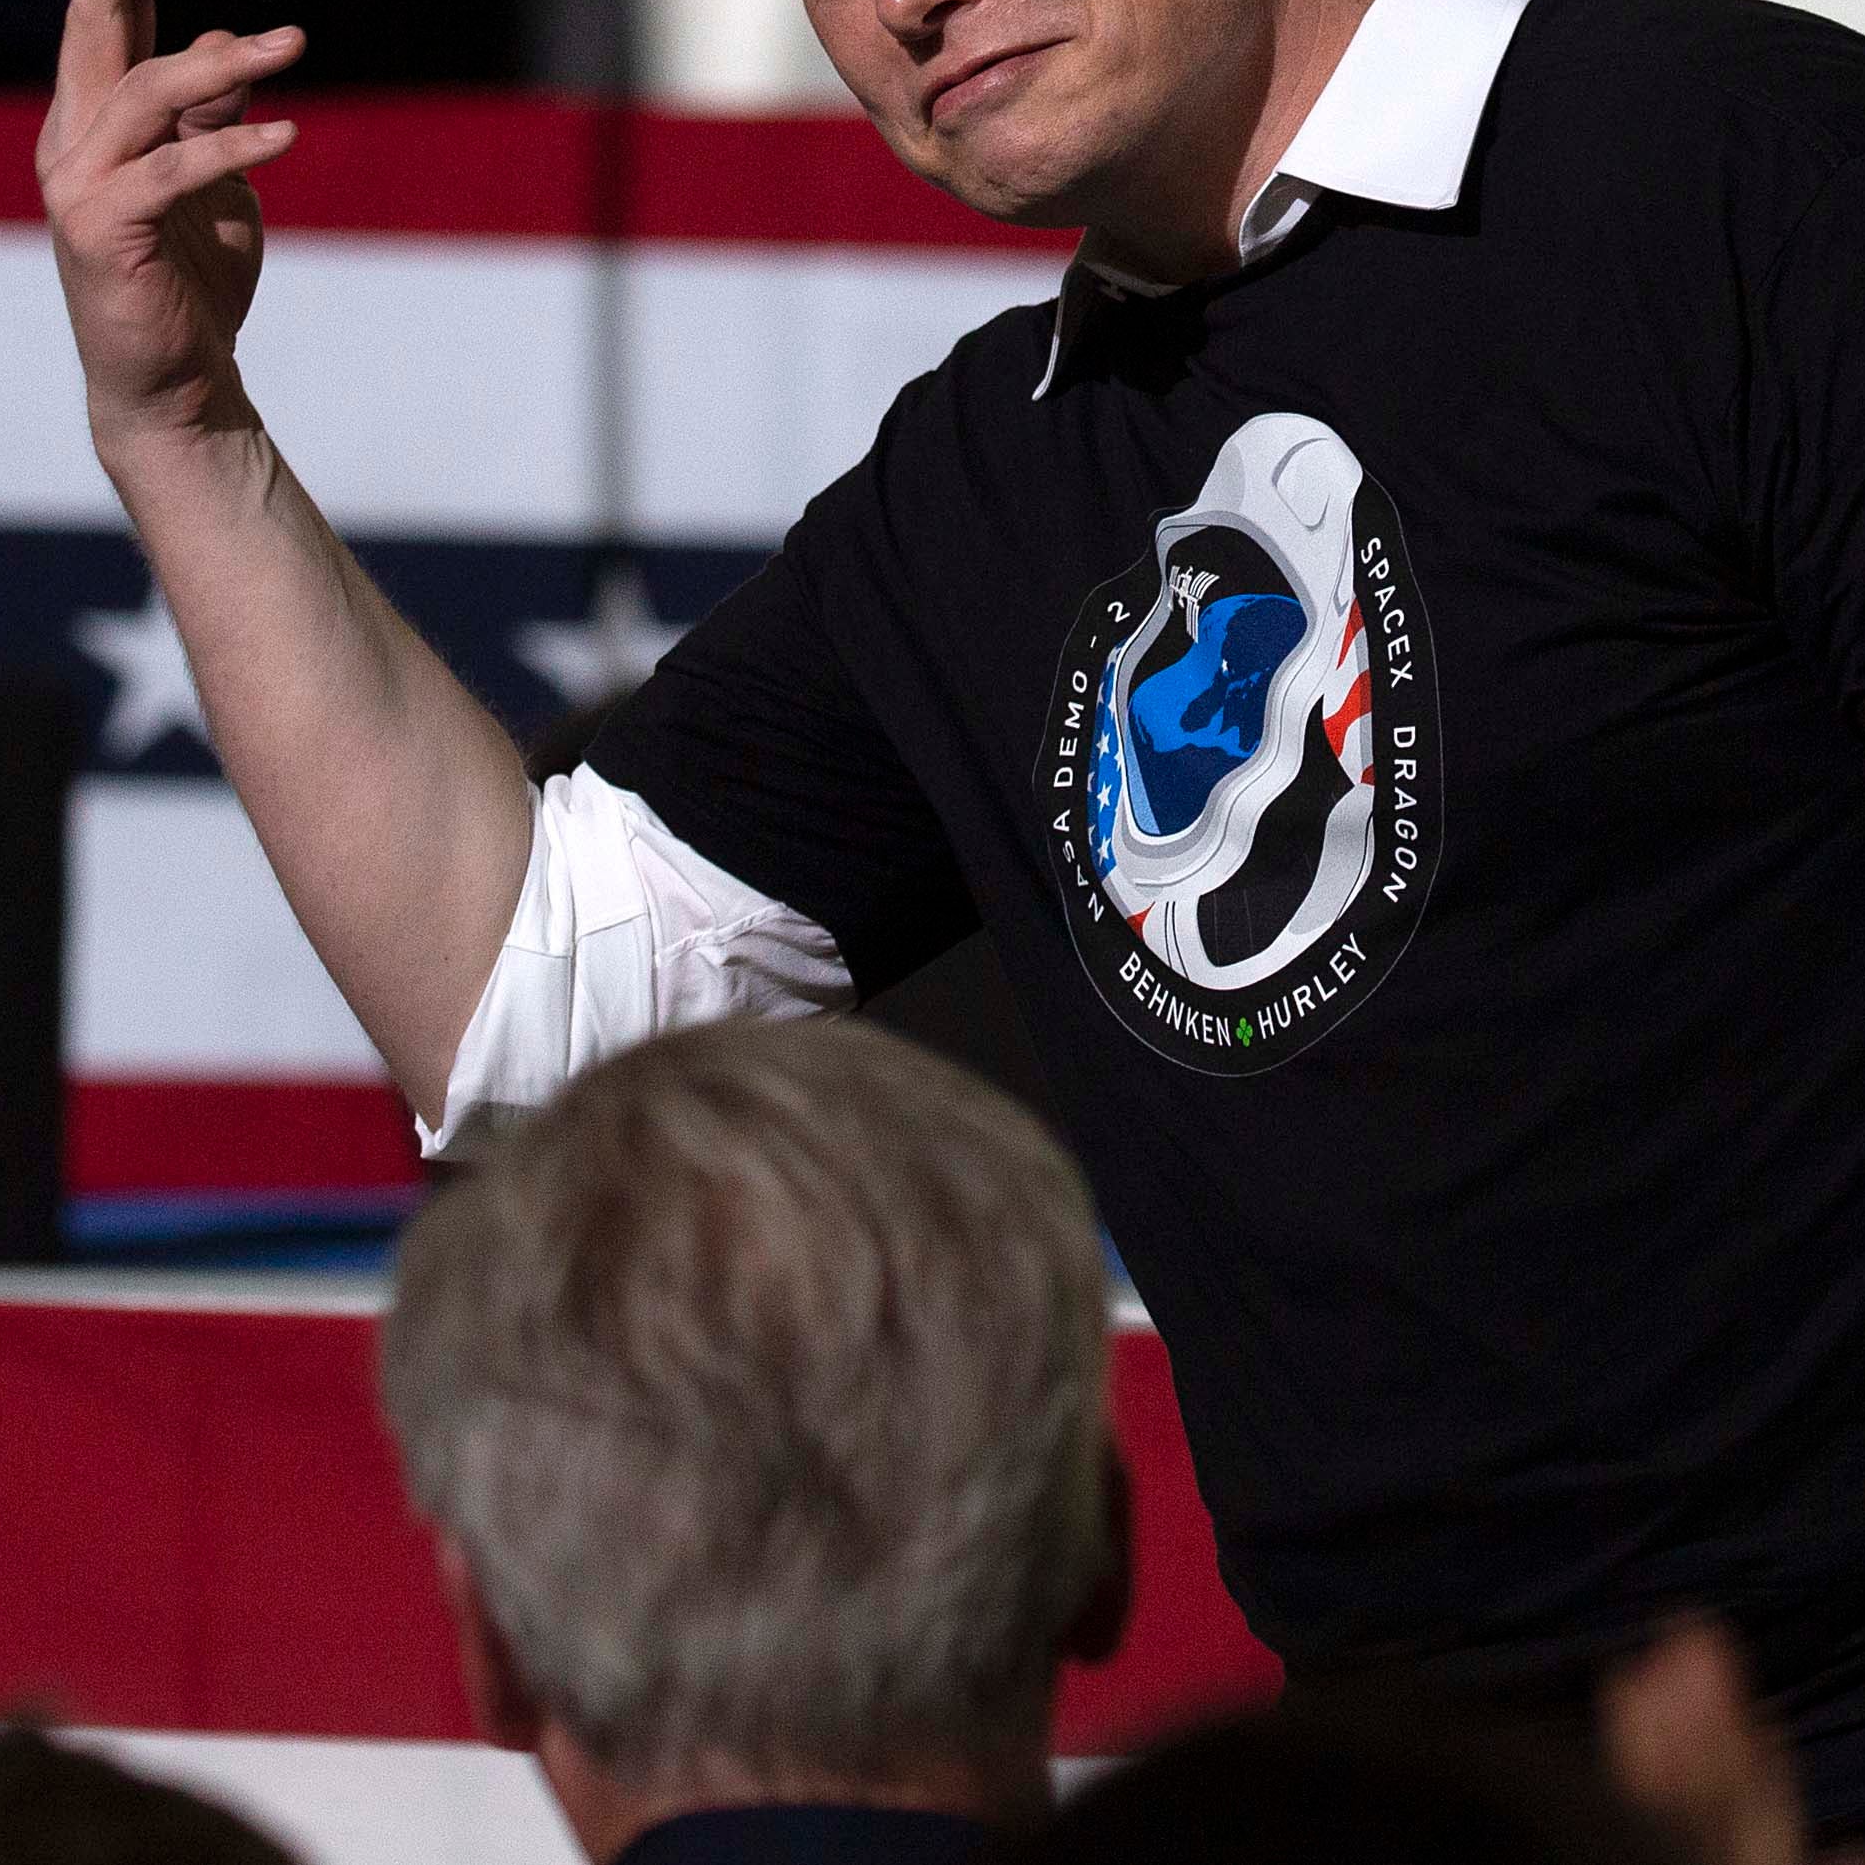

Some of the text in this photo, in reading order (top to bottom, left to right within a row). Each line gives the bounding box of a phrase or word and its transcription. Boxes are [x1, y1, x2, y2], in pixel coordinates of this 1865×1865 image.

[1106, 600, 1131, 623] 2
[1053, 669, 1088, 788] DEMO
[1359, 535, 1419, 903] SPACEX DRAGON
[1052, 808, 1105, 923] NASA
[1118, 932, 1368, 1047] BEHNKEN HURLEY
